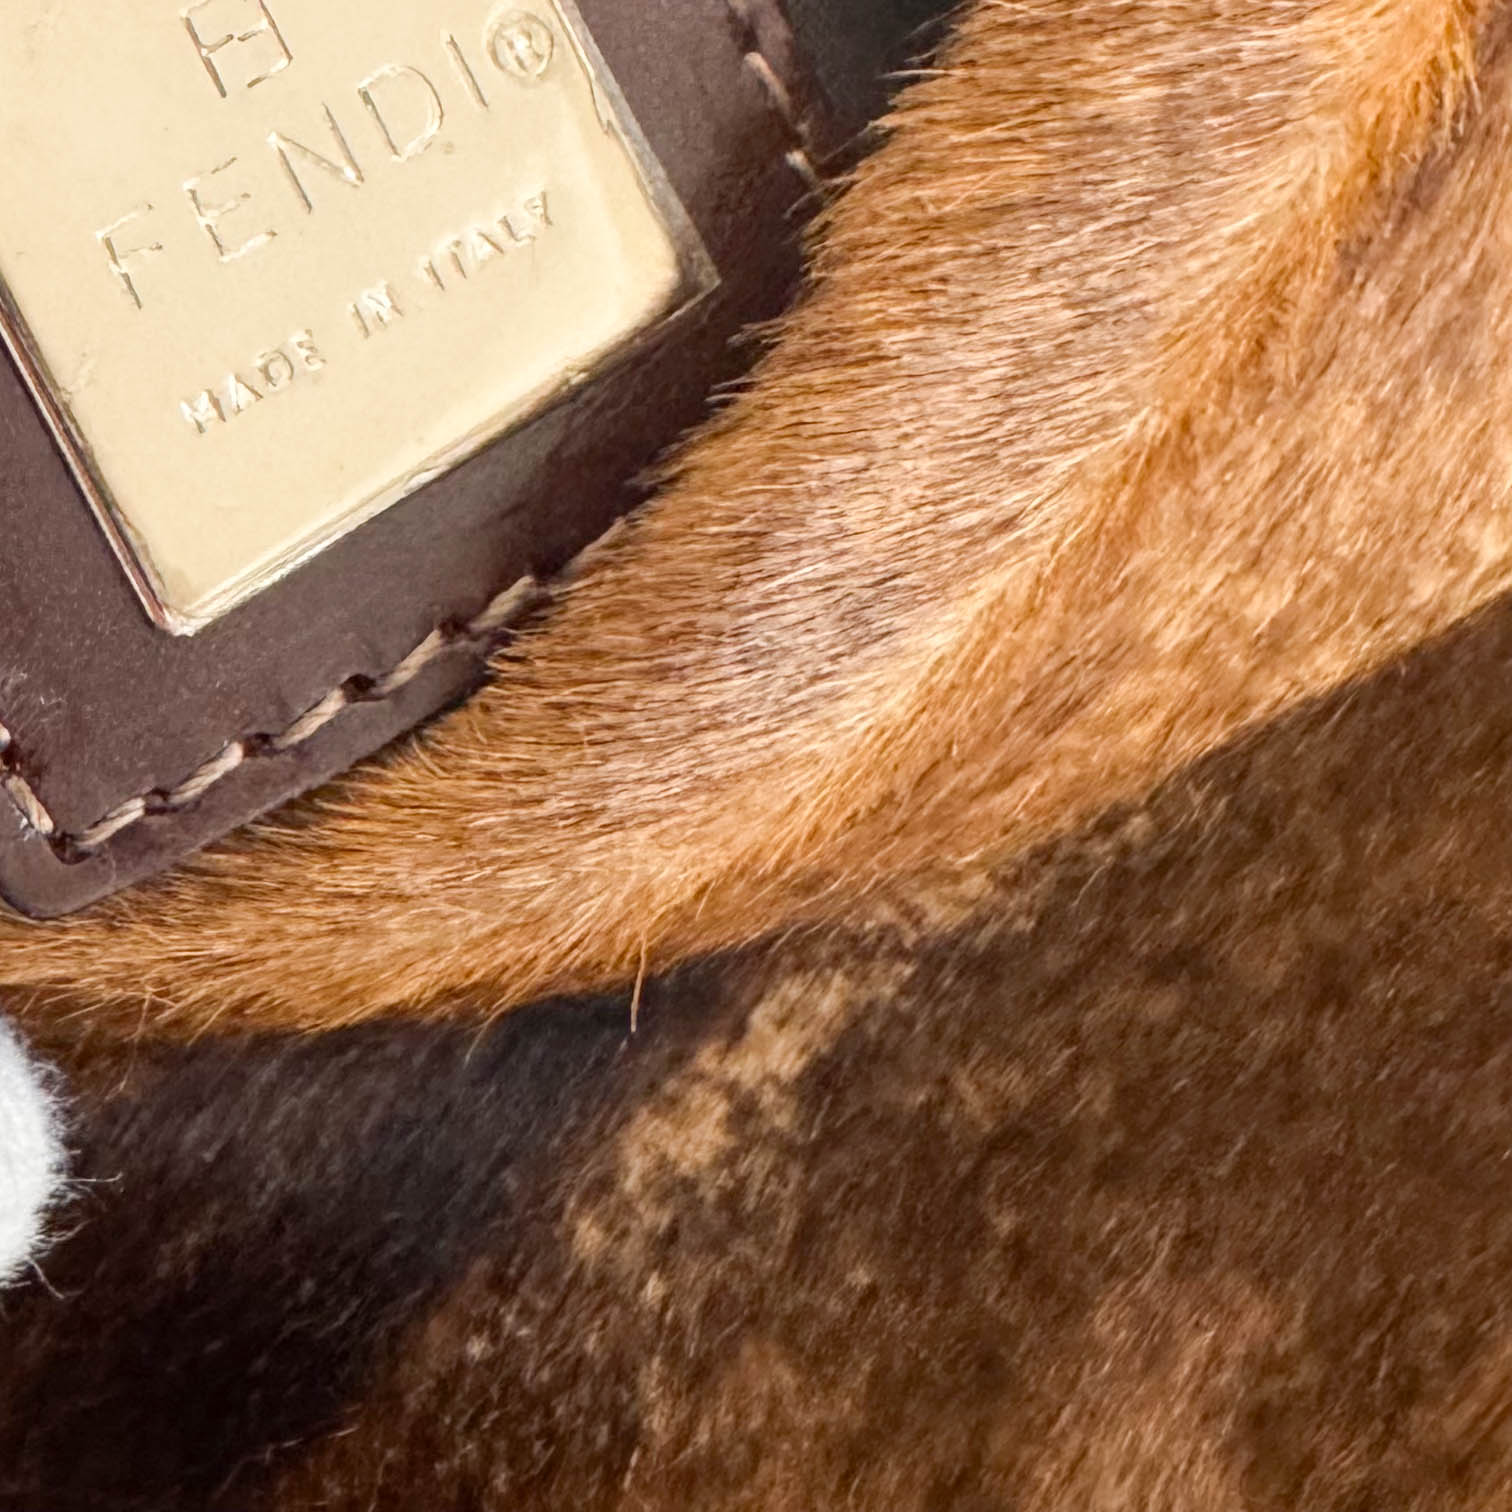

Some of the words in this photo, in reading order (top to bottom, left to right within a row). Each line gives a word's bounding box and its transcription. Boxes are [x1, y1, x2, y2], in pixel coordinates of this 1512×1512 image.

[178, 328, 328, 435] MADE
[348, 280, 405, 338] IN
[421, 188, 555, 292] ITALY
